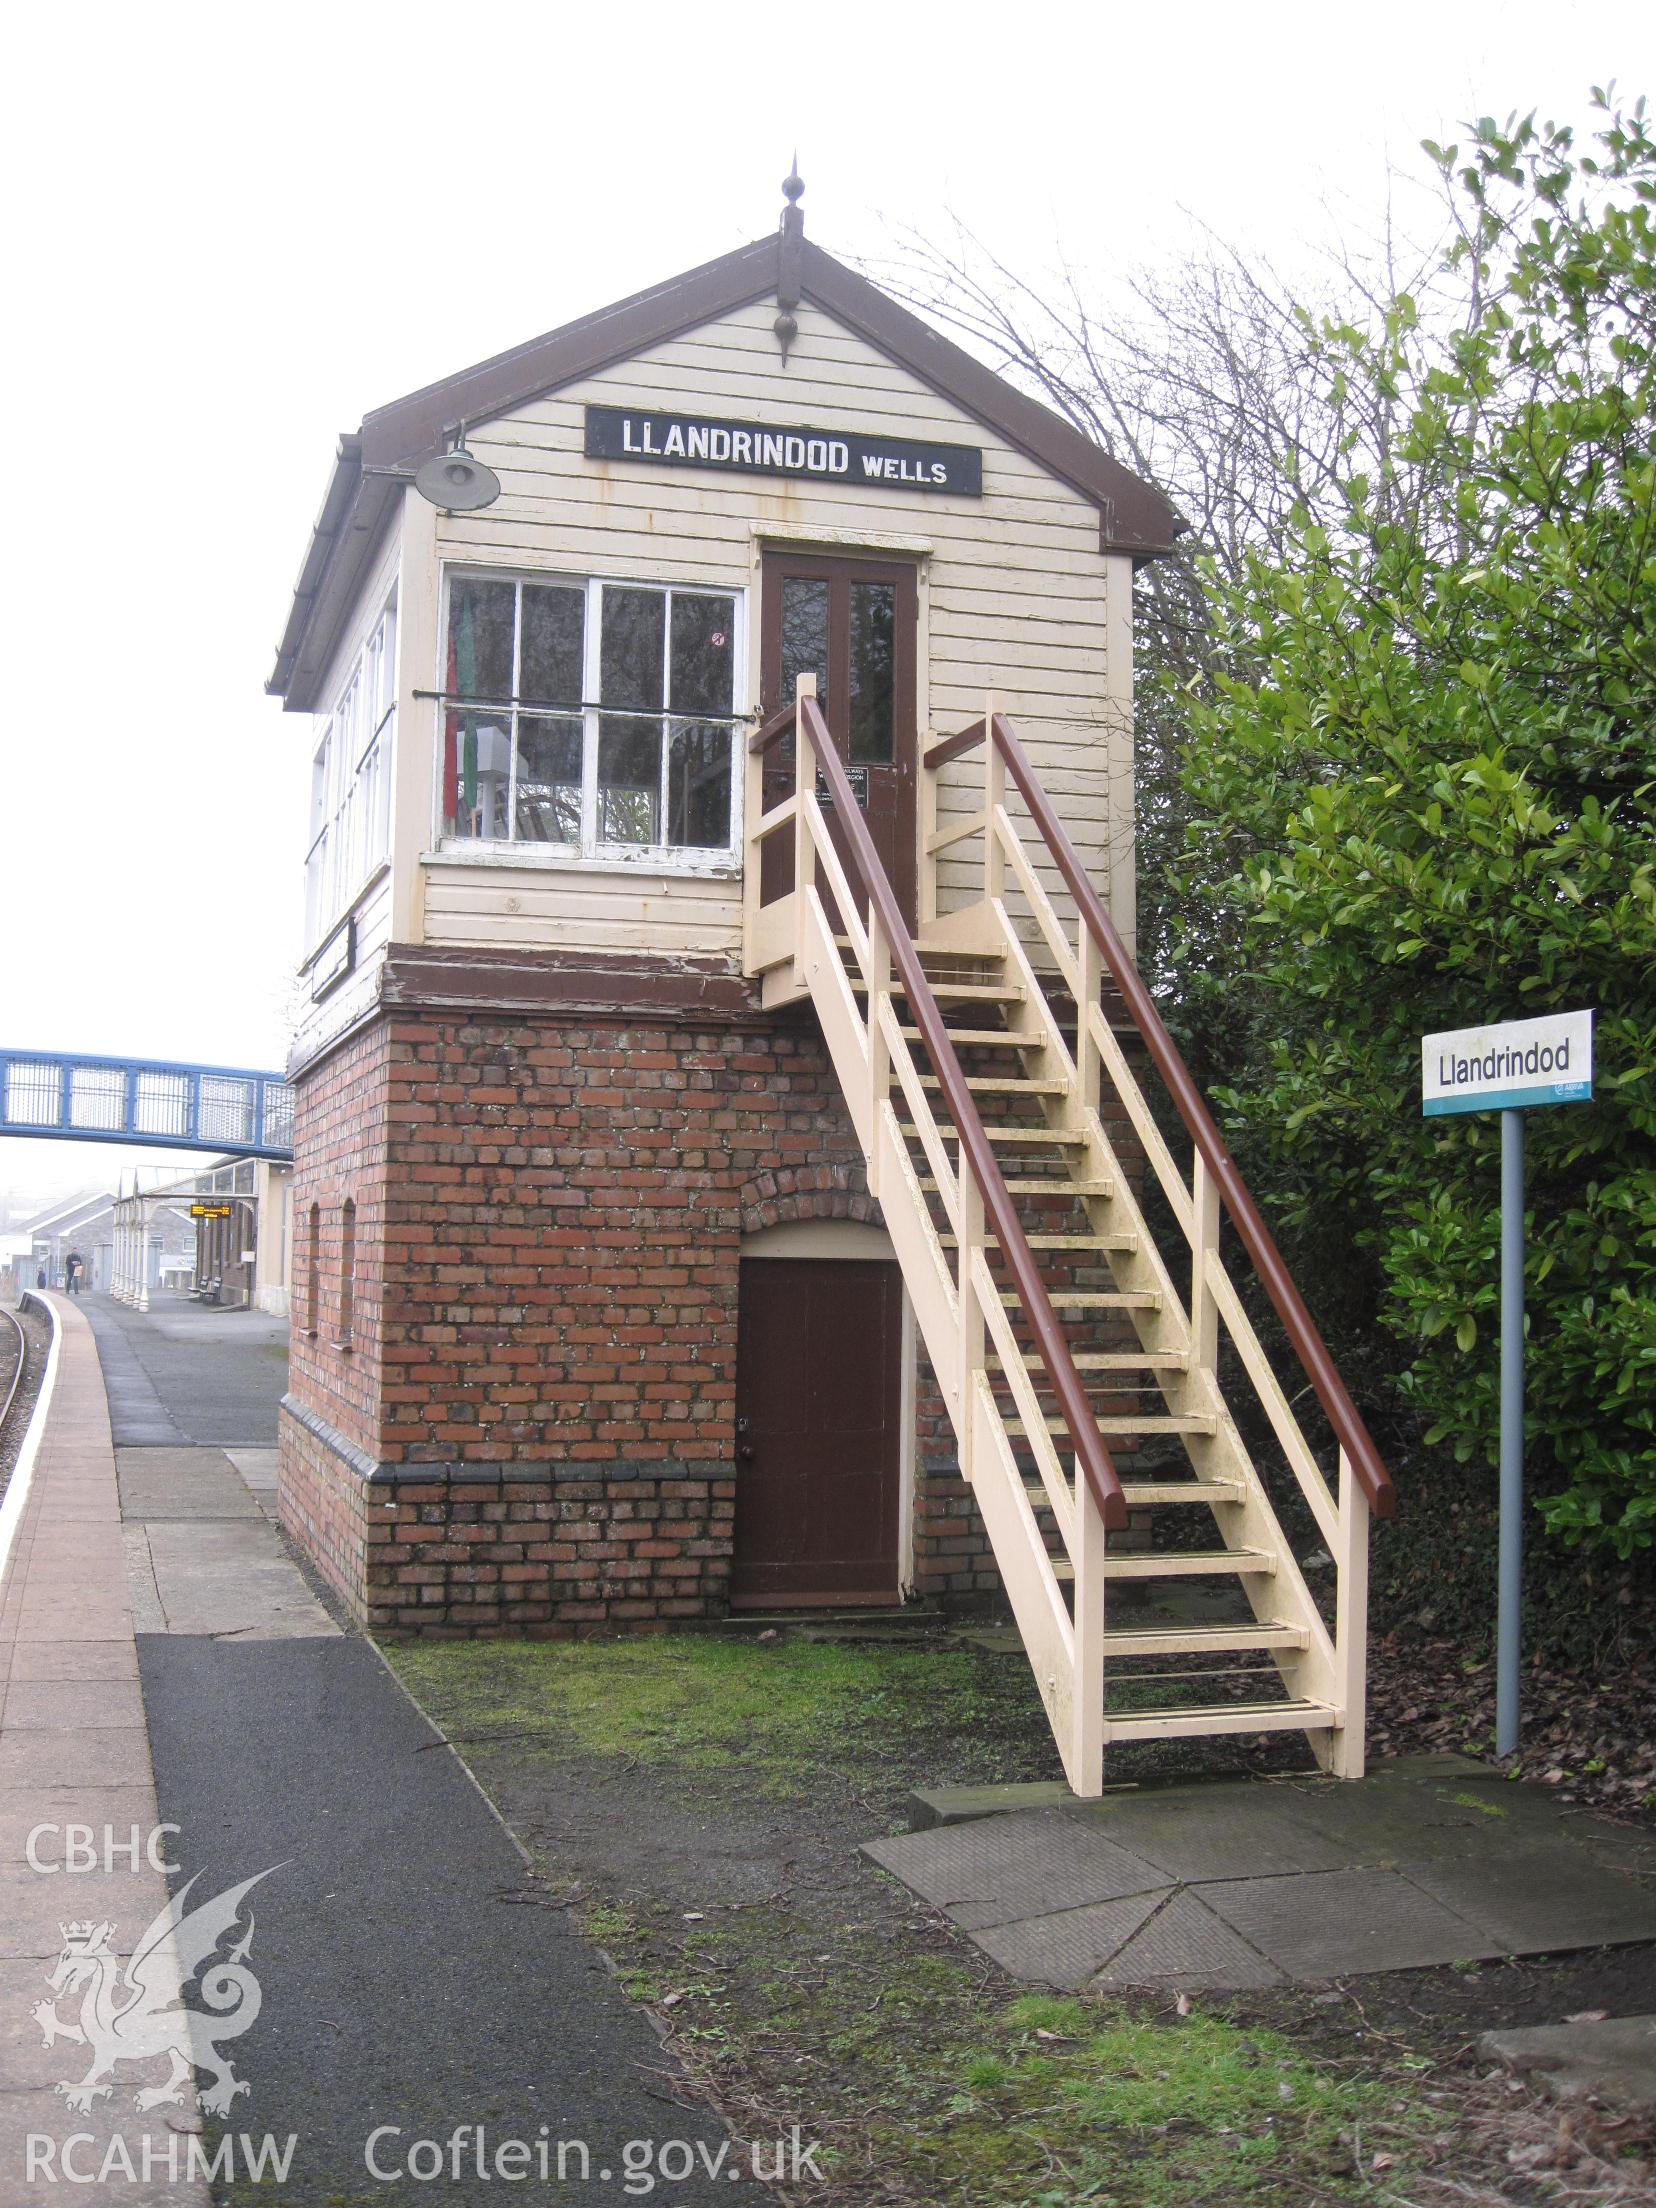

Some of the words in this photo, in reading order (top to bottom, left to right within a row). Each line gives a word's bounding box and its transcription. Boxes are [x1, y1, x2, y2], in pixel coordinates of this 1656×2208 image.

[622, 419, 849, 473] LLANDRINDOD
[862, 454, 947, 485] WELLS
[1439, 1037, 1570, 1086] Llandrindod
